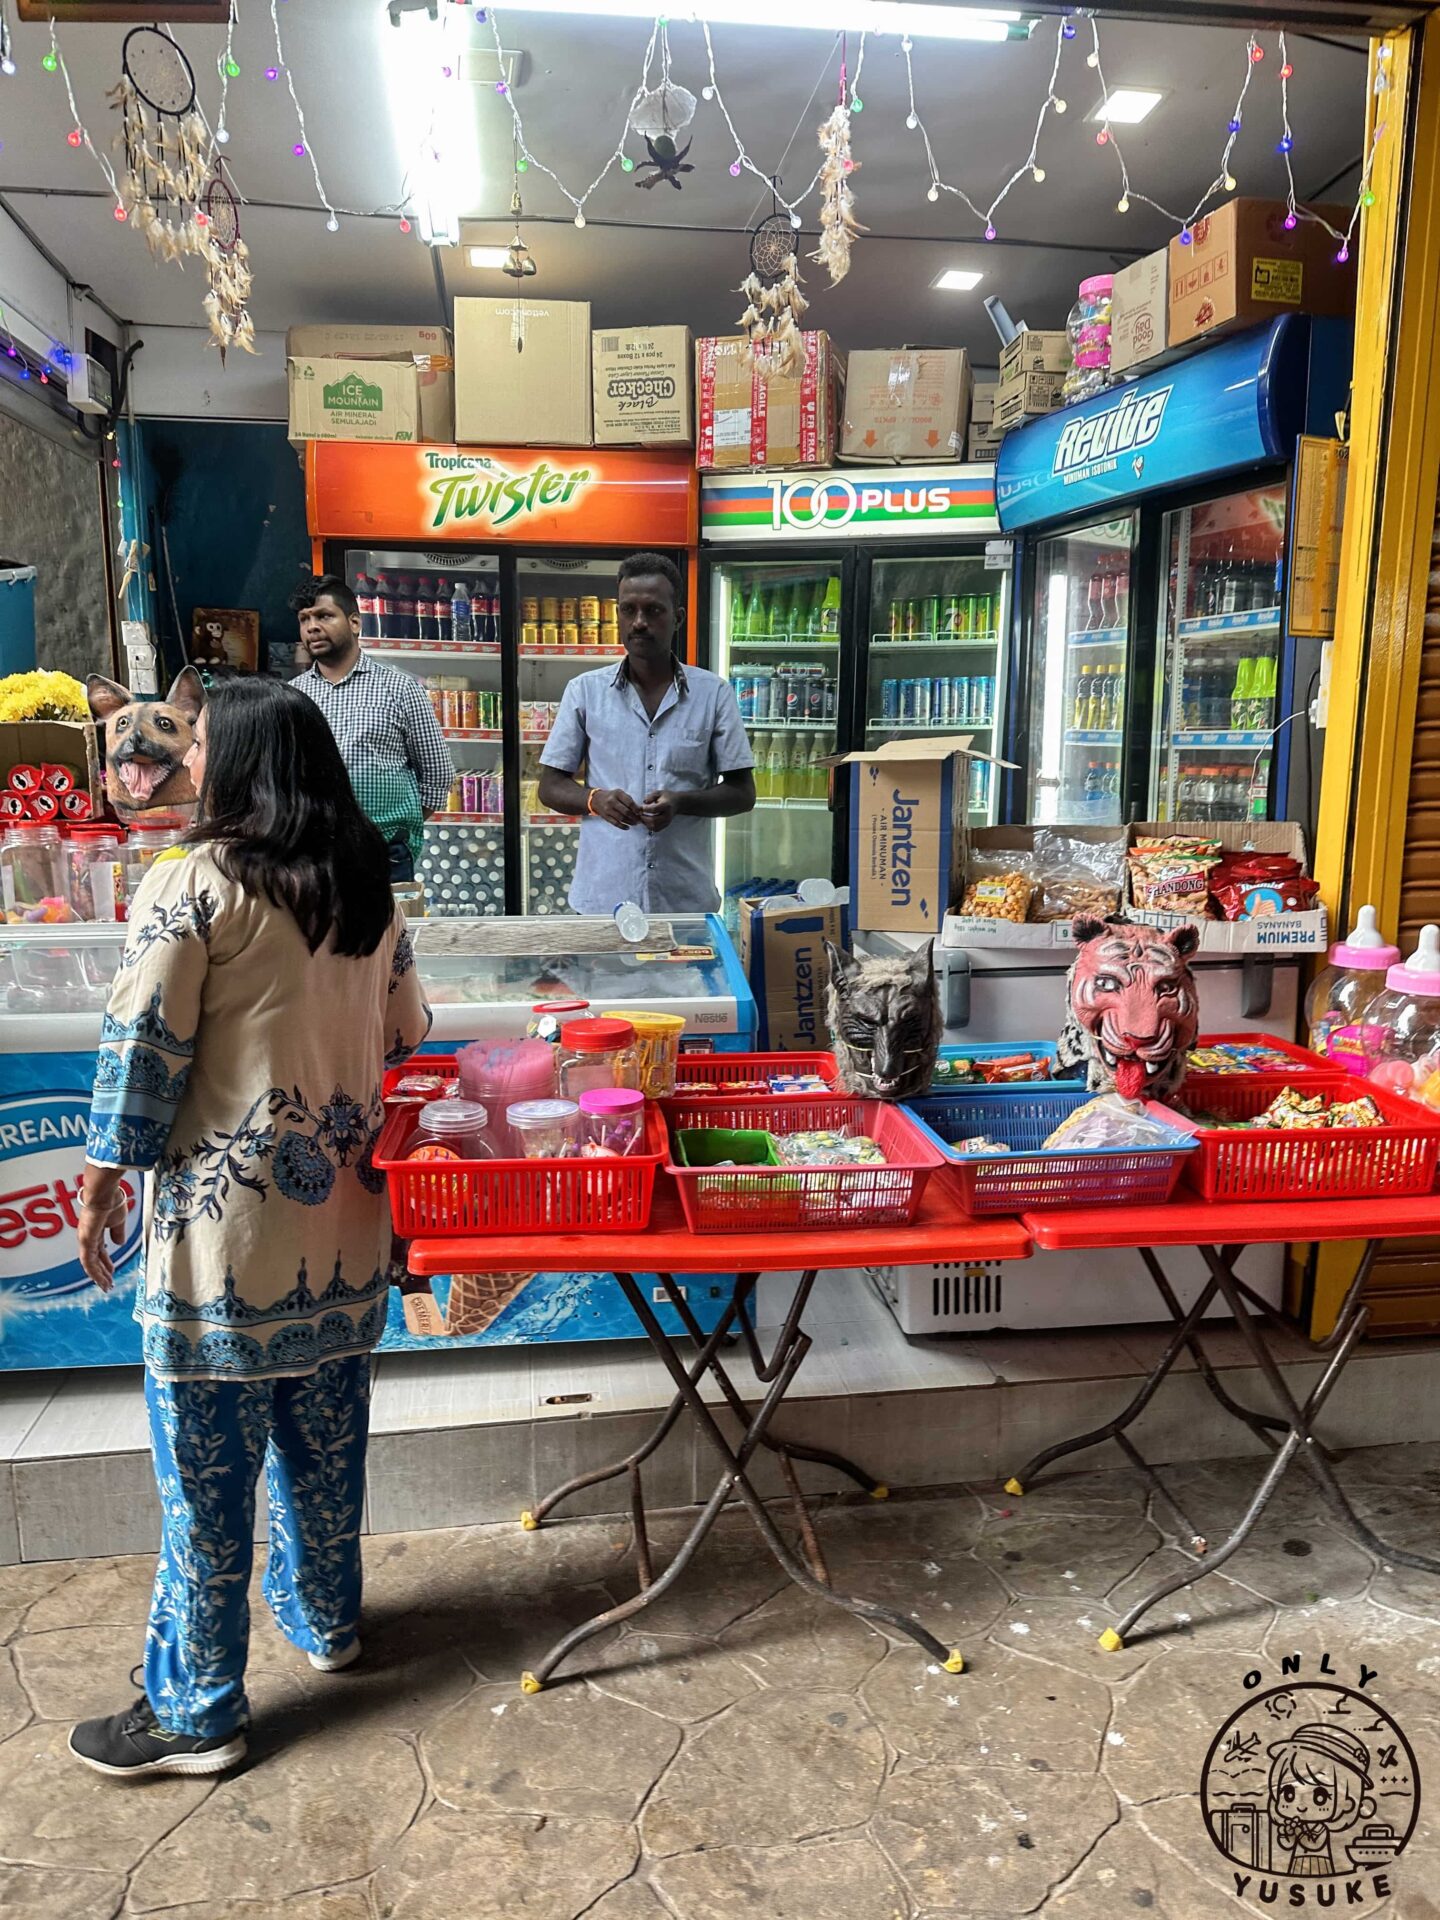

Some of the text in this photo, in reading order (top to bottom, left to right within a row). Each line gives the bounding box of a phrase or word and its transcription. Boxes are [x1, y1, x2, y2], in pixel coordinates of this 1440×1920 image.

[1136, 317, 1151, 335] Day
[1133, 329, 1153, 350] Good
[342, 385, 363, 396] ICE
[608, 378, 675, 399] Checker
[758, 378, 766, 417] AGILE
[327, 396, 379, 407] MOUNTAIN
[618, 396, 658, 411] Black
[331, 418, 377, 426] SEMULAJADI
[344, 411, 377, 419] MINERAL
[1052, 386, 1173, 477] Revive
[425, 452, 492, 470] Tropicana
[429, 463, 592, 527] Twister
[767, 477, 951, 531] 100 PLUS
[879, 814, 888, 880] AIR MINUMAN
[891, 788, 920, 906] Jantzen
[1257, 920, 1302, 929] BANANAS
[1257, 930, 1315, 944] PREMIUM
[794, 947, 815, 1044] Jantzen
[0, 1114, 89, 1150] REAM
